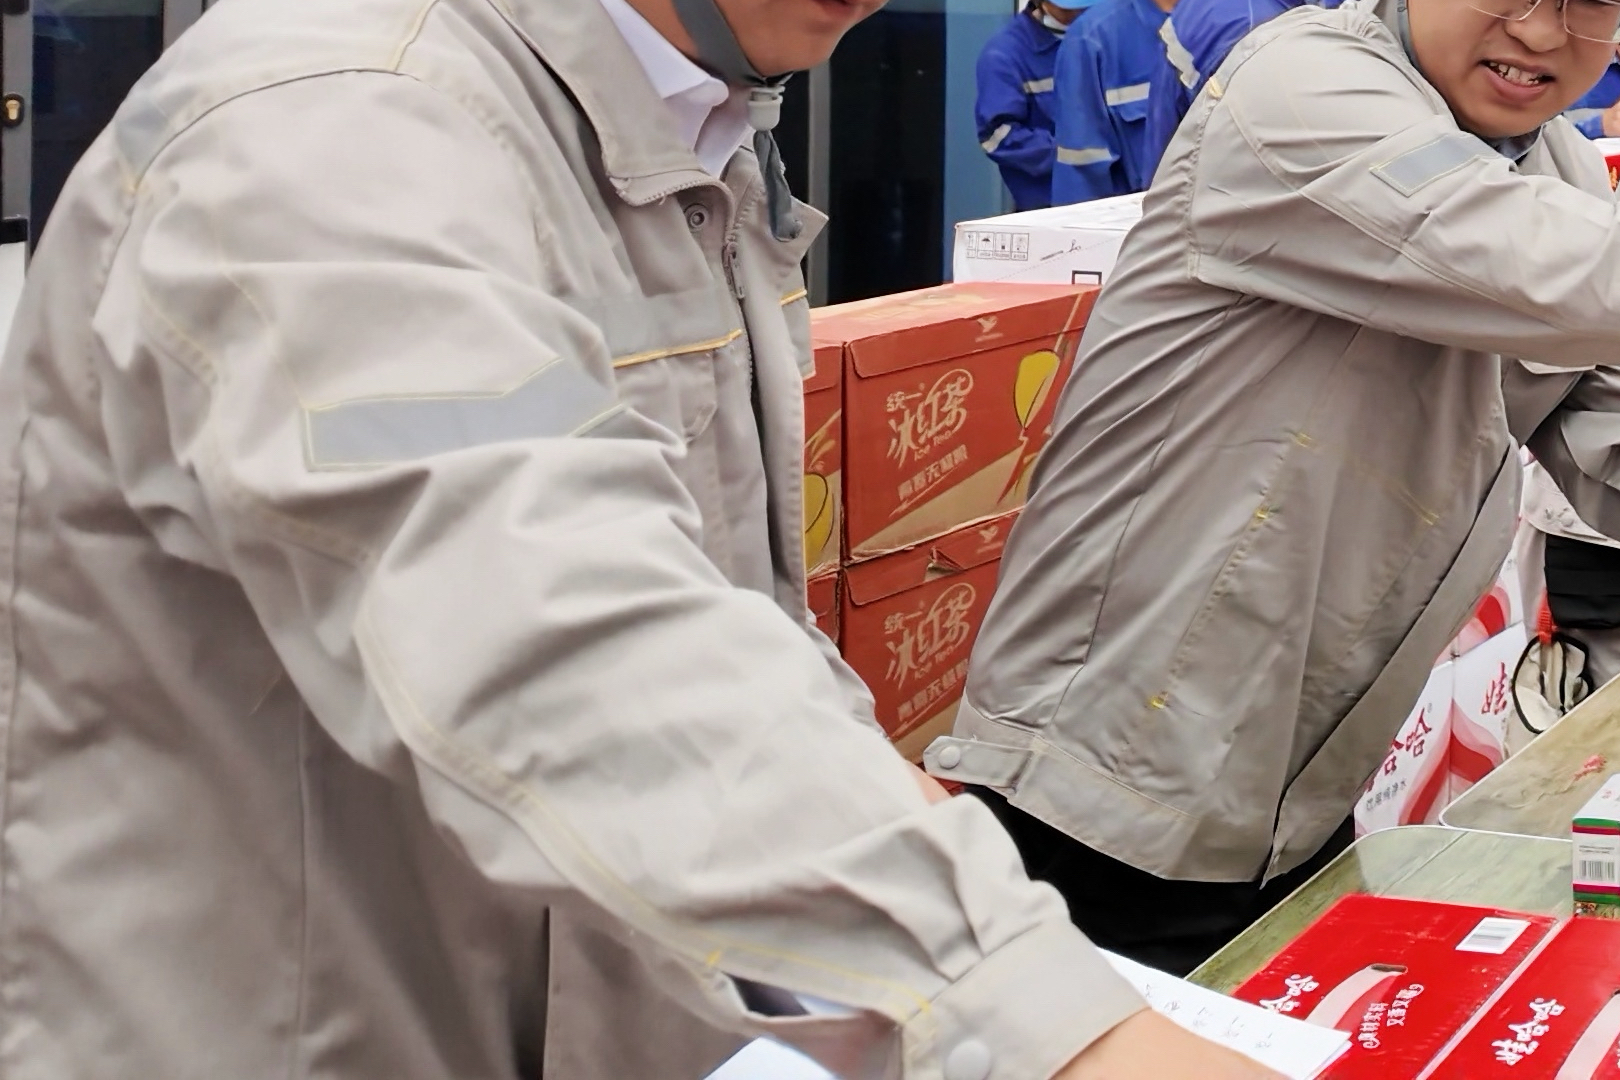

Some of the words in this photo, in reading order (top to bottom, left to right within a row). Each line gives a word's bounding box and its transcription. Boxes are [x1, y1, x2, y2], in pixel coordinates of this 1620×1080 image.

[886, 391, 923, 412] 统一
[886, 369, 974, 469] 冰红茶
[1491, 998, 1566, 1066] 娃哈哈
